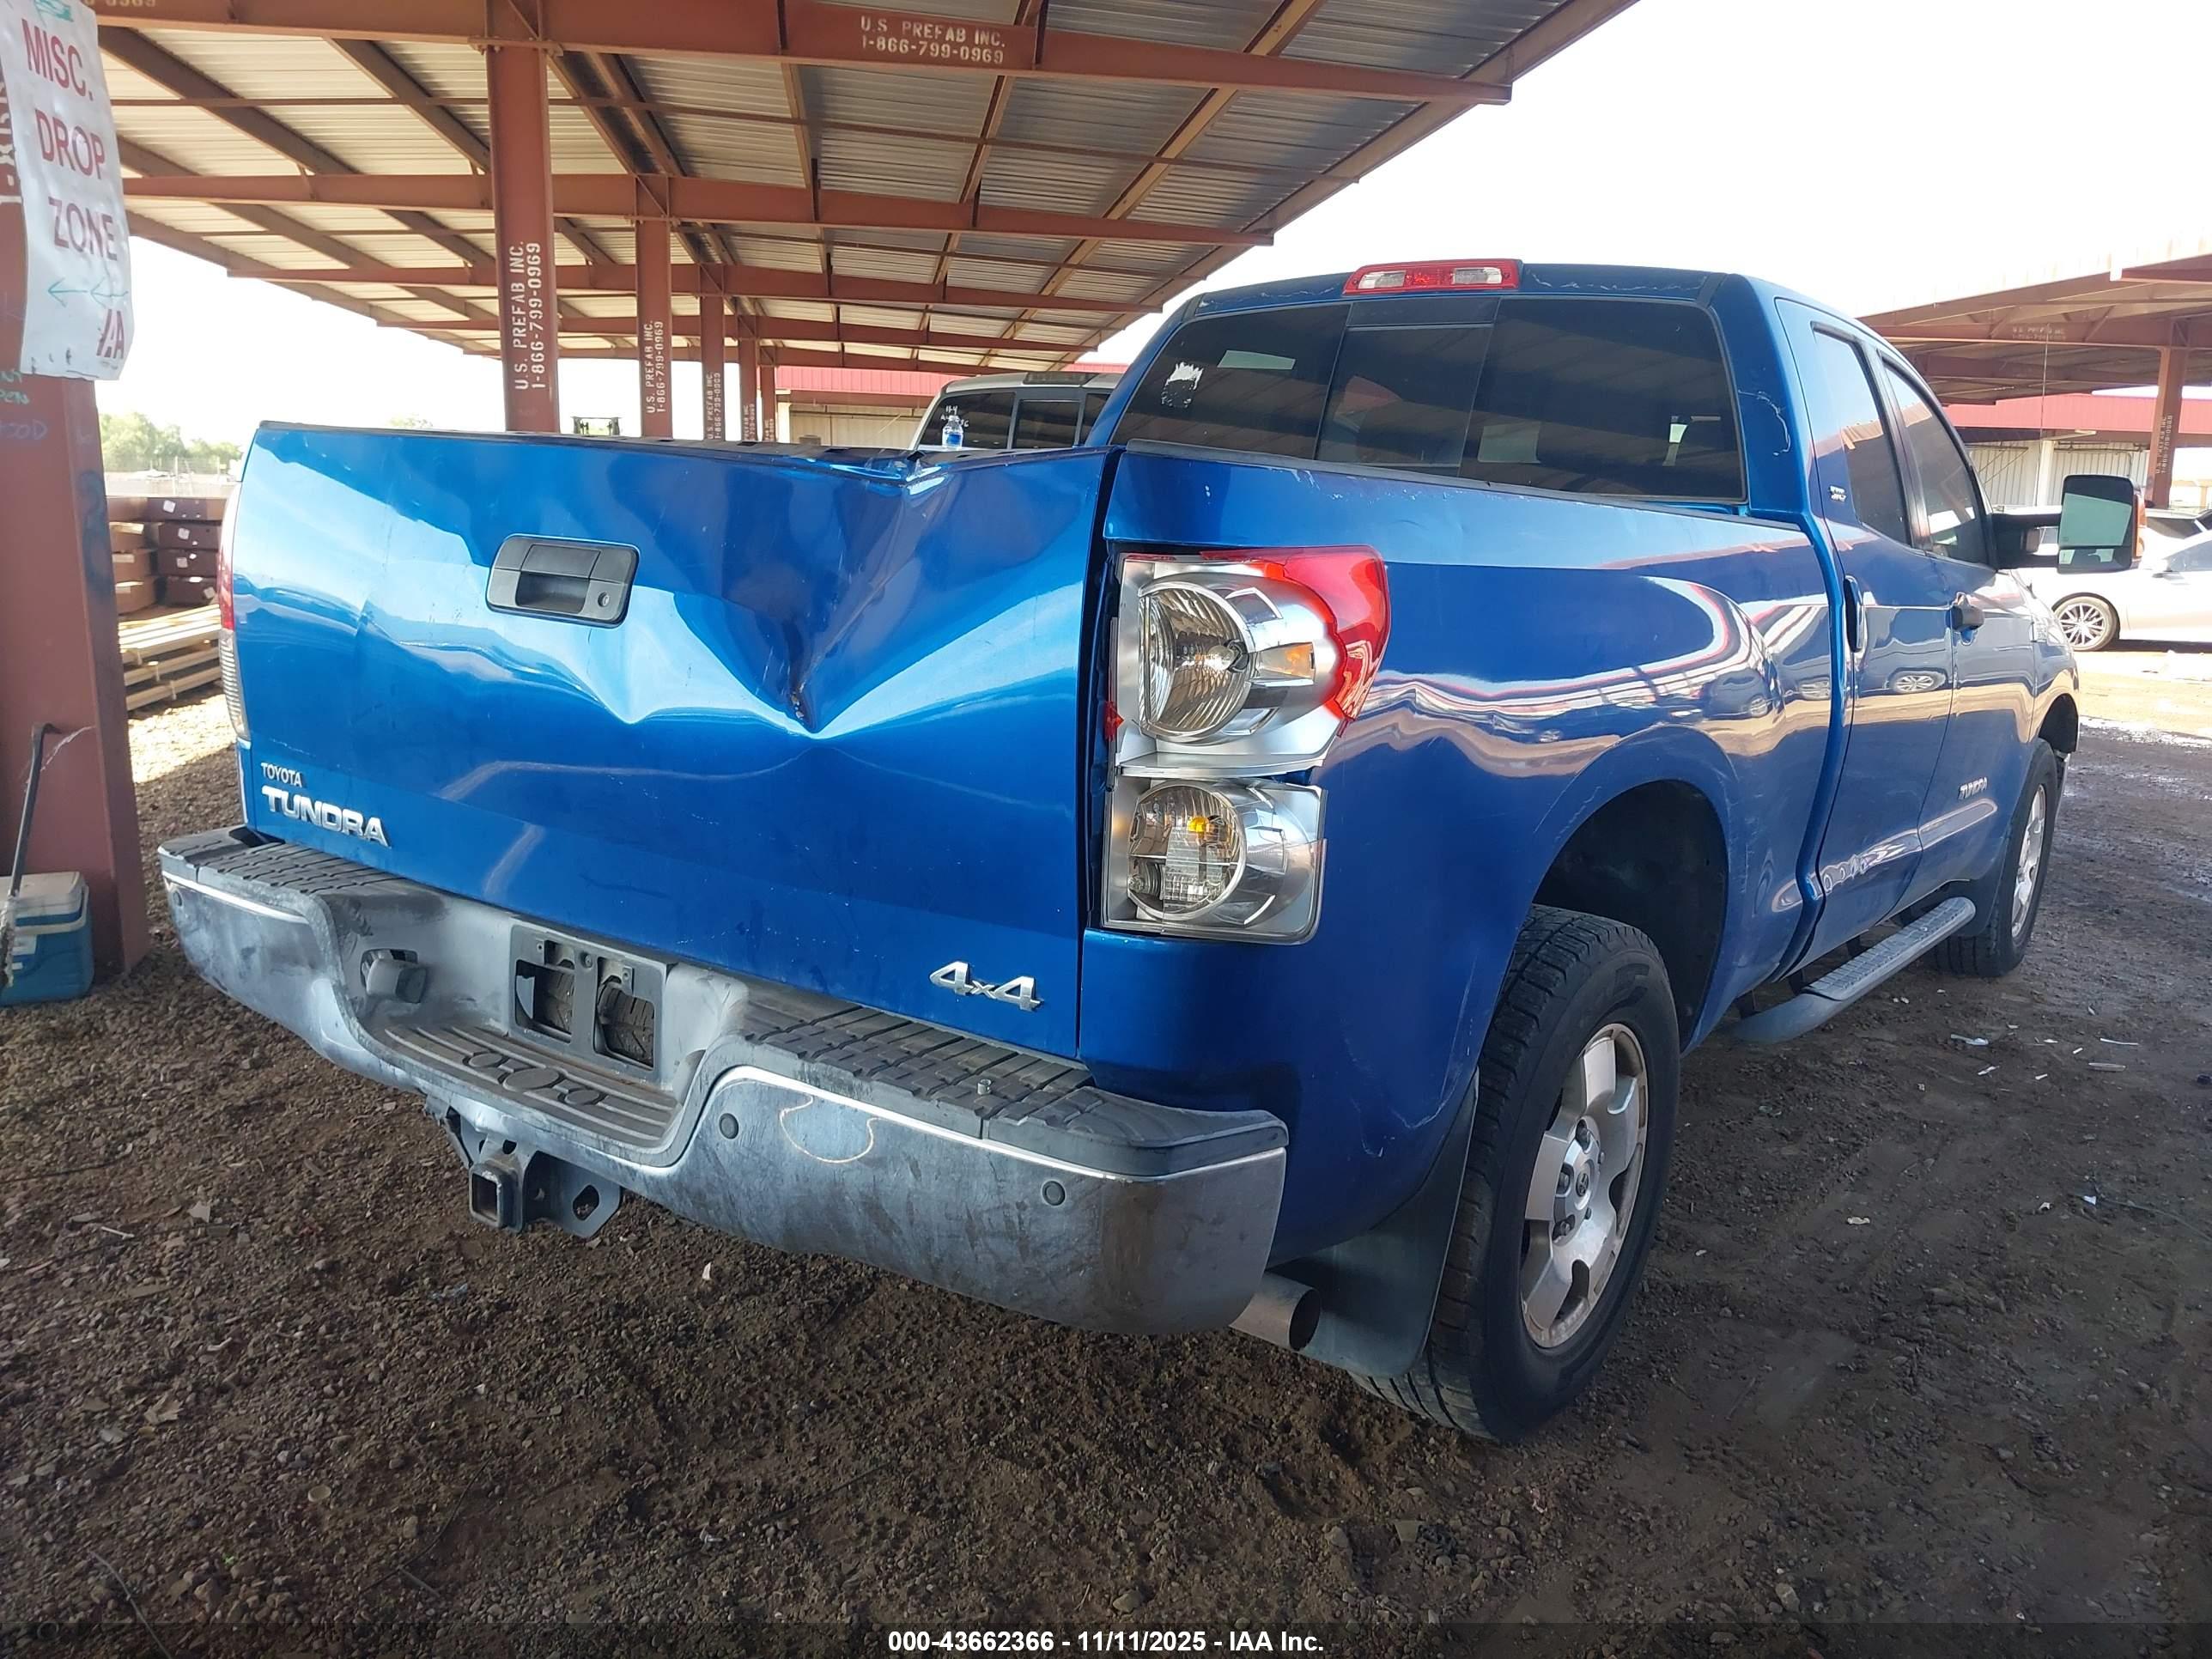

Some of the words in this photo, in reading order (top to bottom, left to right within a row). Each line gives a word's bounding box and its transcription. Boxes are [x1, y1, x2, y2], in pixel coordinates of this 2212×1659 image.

[21, 17, 94, 101] MISC.
[861, 35, 1004, 64] 1-866-799-0969
[902, 21, 966, 44] PREFAB
[975, 29, 1006, 48] INC.
[35, 108, 106, 180] DROP
[48, 196, 118, 261] ZONE
[508, 240, 526, 274] INC.
[510, 282, 528, 349] PREFAB
[525, 242, 546, 389] 1-866-799-0969
[643, 319, 654, 341] INC.
[514, 357, 530, 390] U.S.
[644, 345, 655, 388] PREFAB
[653, 320, 666, 413] 1-866-799-0969
[260, 762, 303, 788] TOYOTA
[261, 785, 392, 849] TUNDRA
